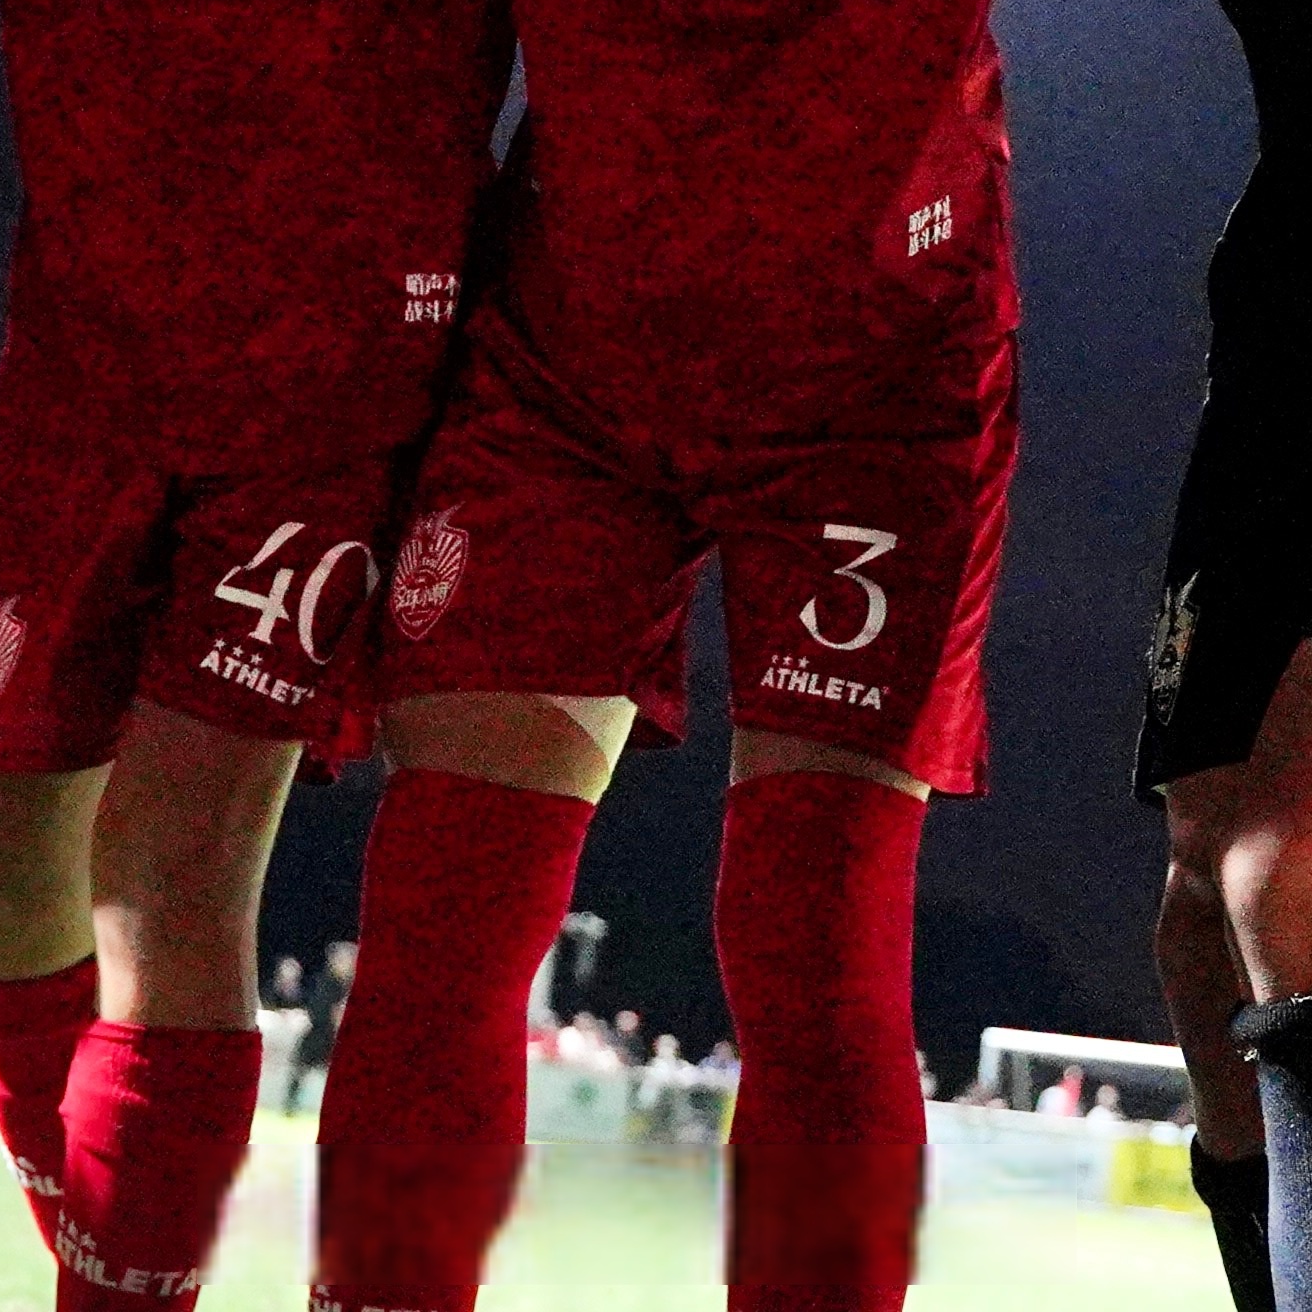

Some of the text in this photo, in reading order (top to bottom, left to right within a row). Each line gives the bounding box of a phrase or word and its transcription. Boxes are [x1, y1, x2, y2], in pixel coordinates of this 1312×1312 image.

[214, 521, 380, 665] 40
[799, 524, 898, 651] 3
[199, 649, 315, 706] ATHLET
[761, 666, 883, 710] ATHLETA
